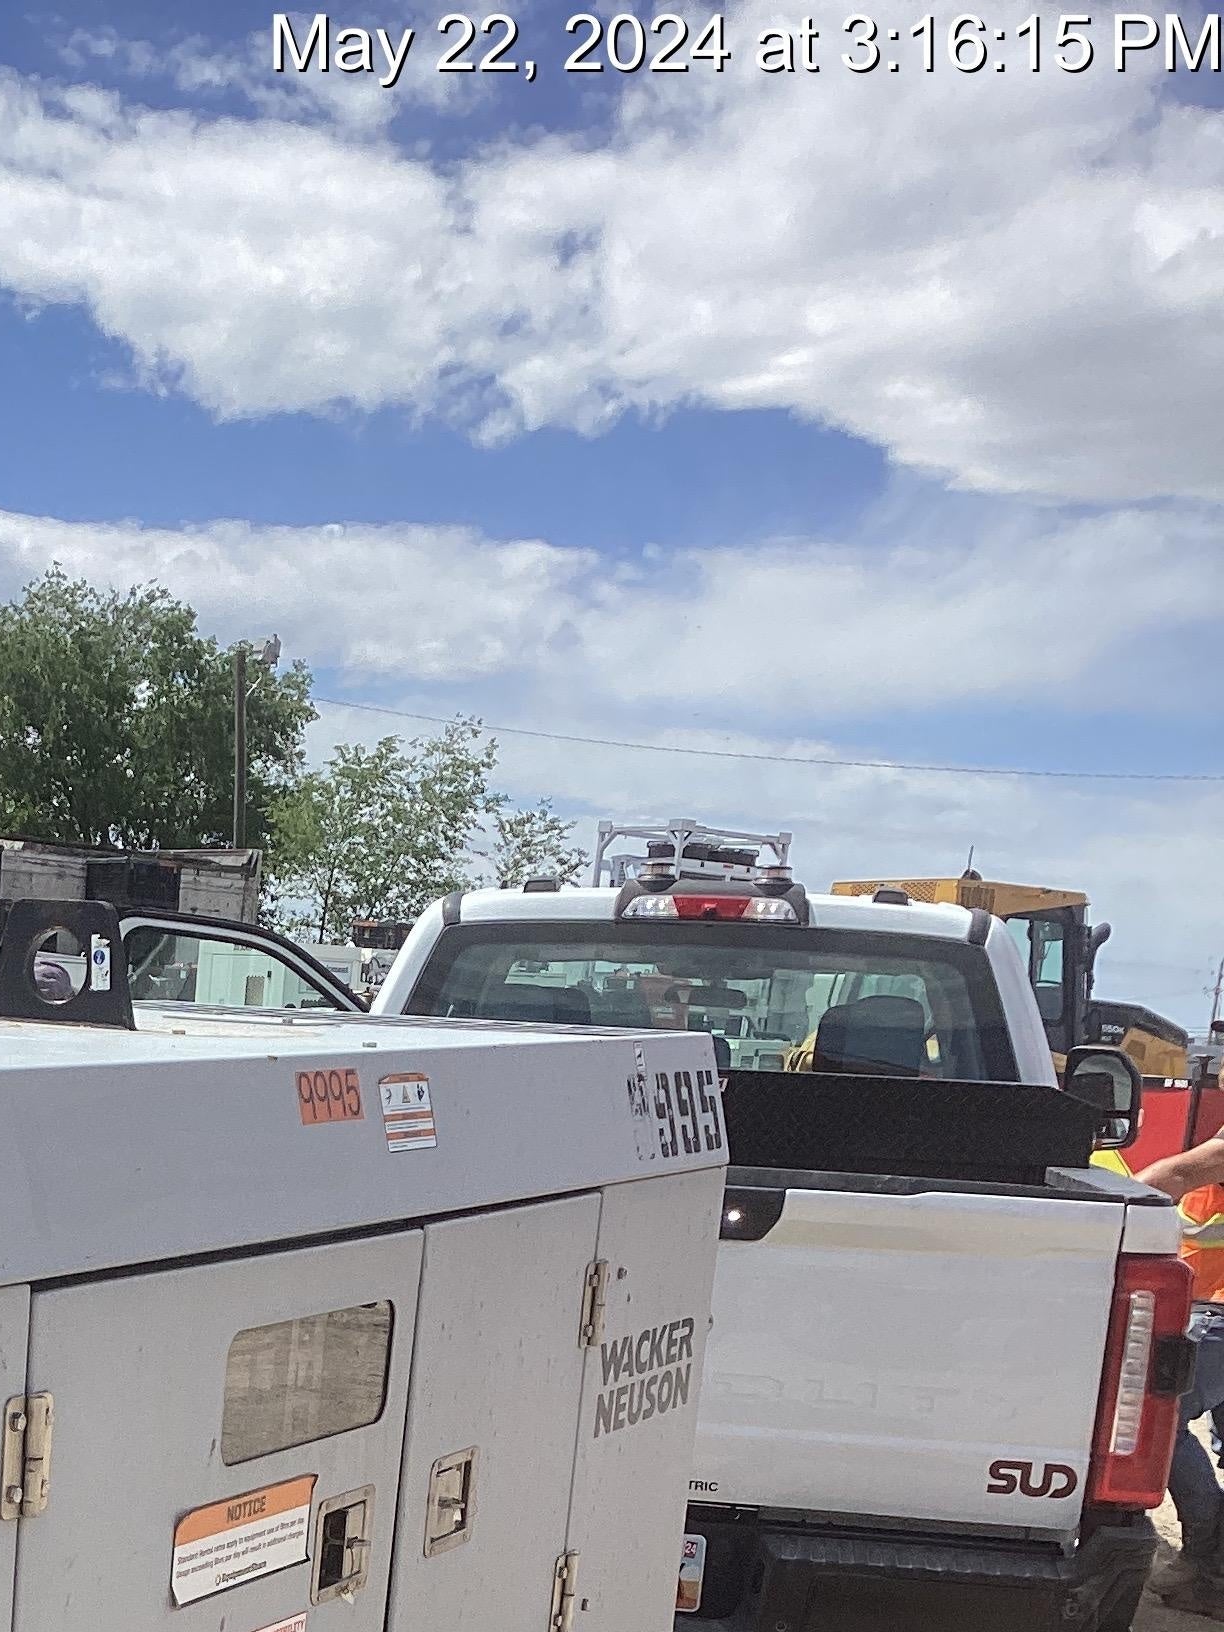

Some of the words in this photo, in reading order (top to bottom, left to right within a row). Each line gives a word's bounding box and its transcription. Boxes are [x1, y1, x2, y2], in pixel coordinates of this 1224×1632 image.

[298, 1068, 361, 1120] 9995
[600, 1316, 695, 1386] WACKER
[593, 1363, 692, 1438] NEUSON
[986, 1460, 1078, 1498] SUD
[226, 1495, 266, 1523] NOTICE
[685, 1542, 698, 1554] 24
